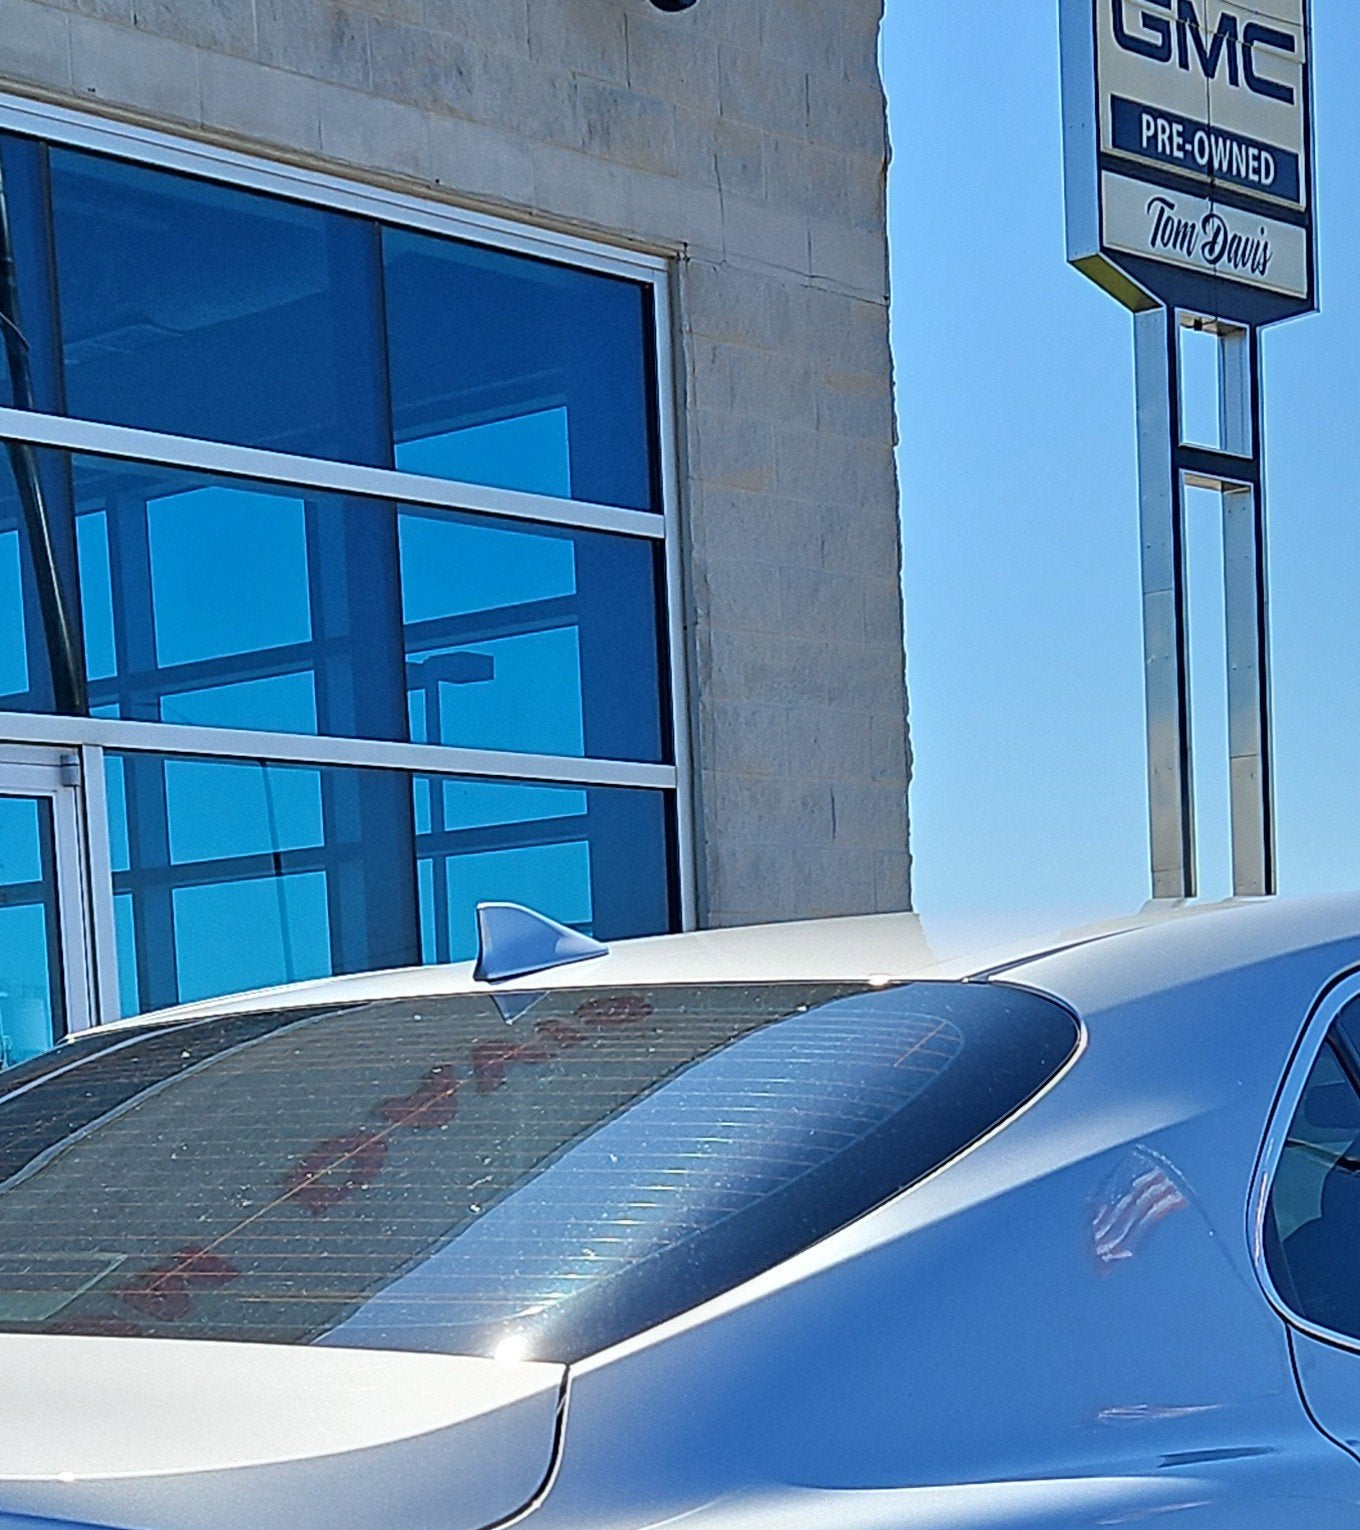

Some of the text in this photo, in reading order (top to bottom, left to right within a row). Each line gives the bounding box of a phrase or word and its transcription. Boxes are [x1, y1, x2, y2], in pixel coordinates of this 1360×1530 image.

[1111, 0, 1296, 105] GMC
[1141, 112, 1276, 186] PRE-OWNED
[1146, 196, 1273, 277] Tom Davis
